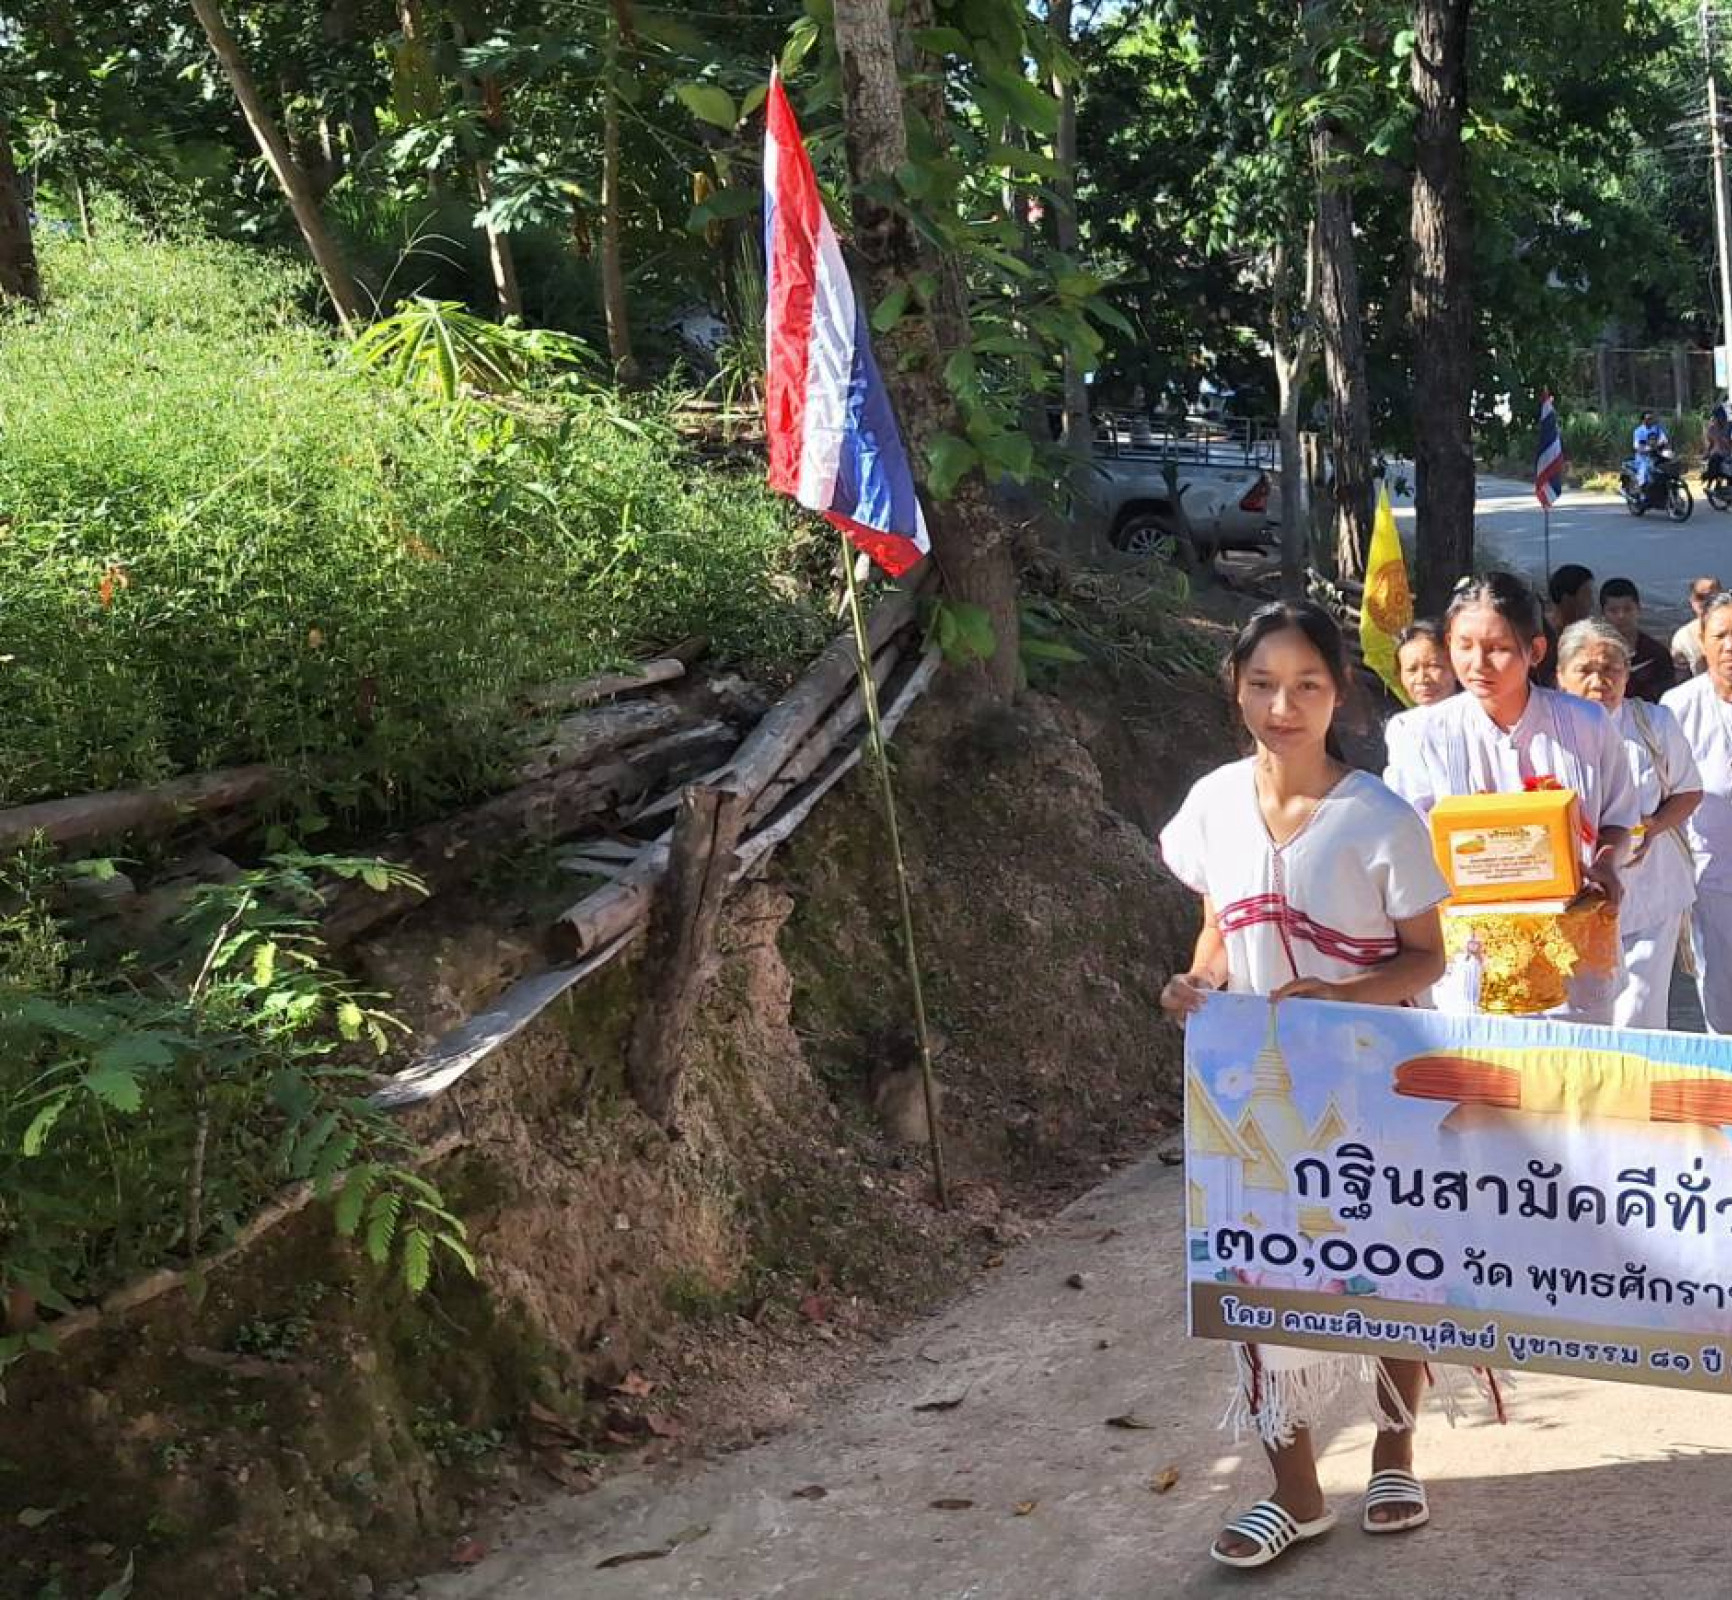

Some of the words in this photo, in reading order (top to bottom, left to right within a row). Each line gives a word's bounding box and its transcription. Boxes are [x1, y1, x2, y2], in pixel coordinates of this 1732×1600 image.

[1215, 1226, 1445, 1281] ๓๐,๐๐๐
[1463, 1246, 1513, 1288] วัด
[1222, 1298, 1273, 1325] โดย
[1284, 1310, 1496, 1352] คณะศิษยานุศิษย์
[1507, 1333, 1639, 1363] บูชาธรรม
[1650, 1350, 1691, 1371] ๘๑
[1702, 1347, 1723, 1374] ปี
